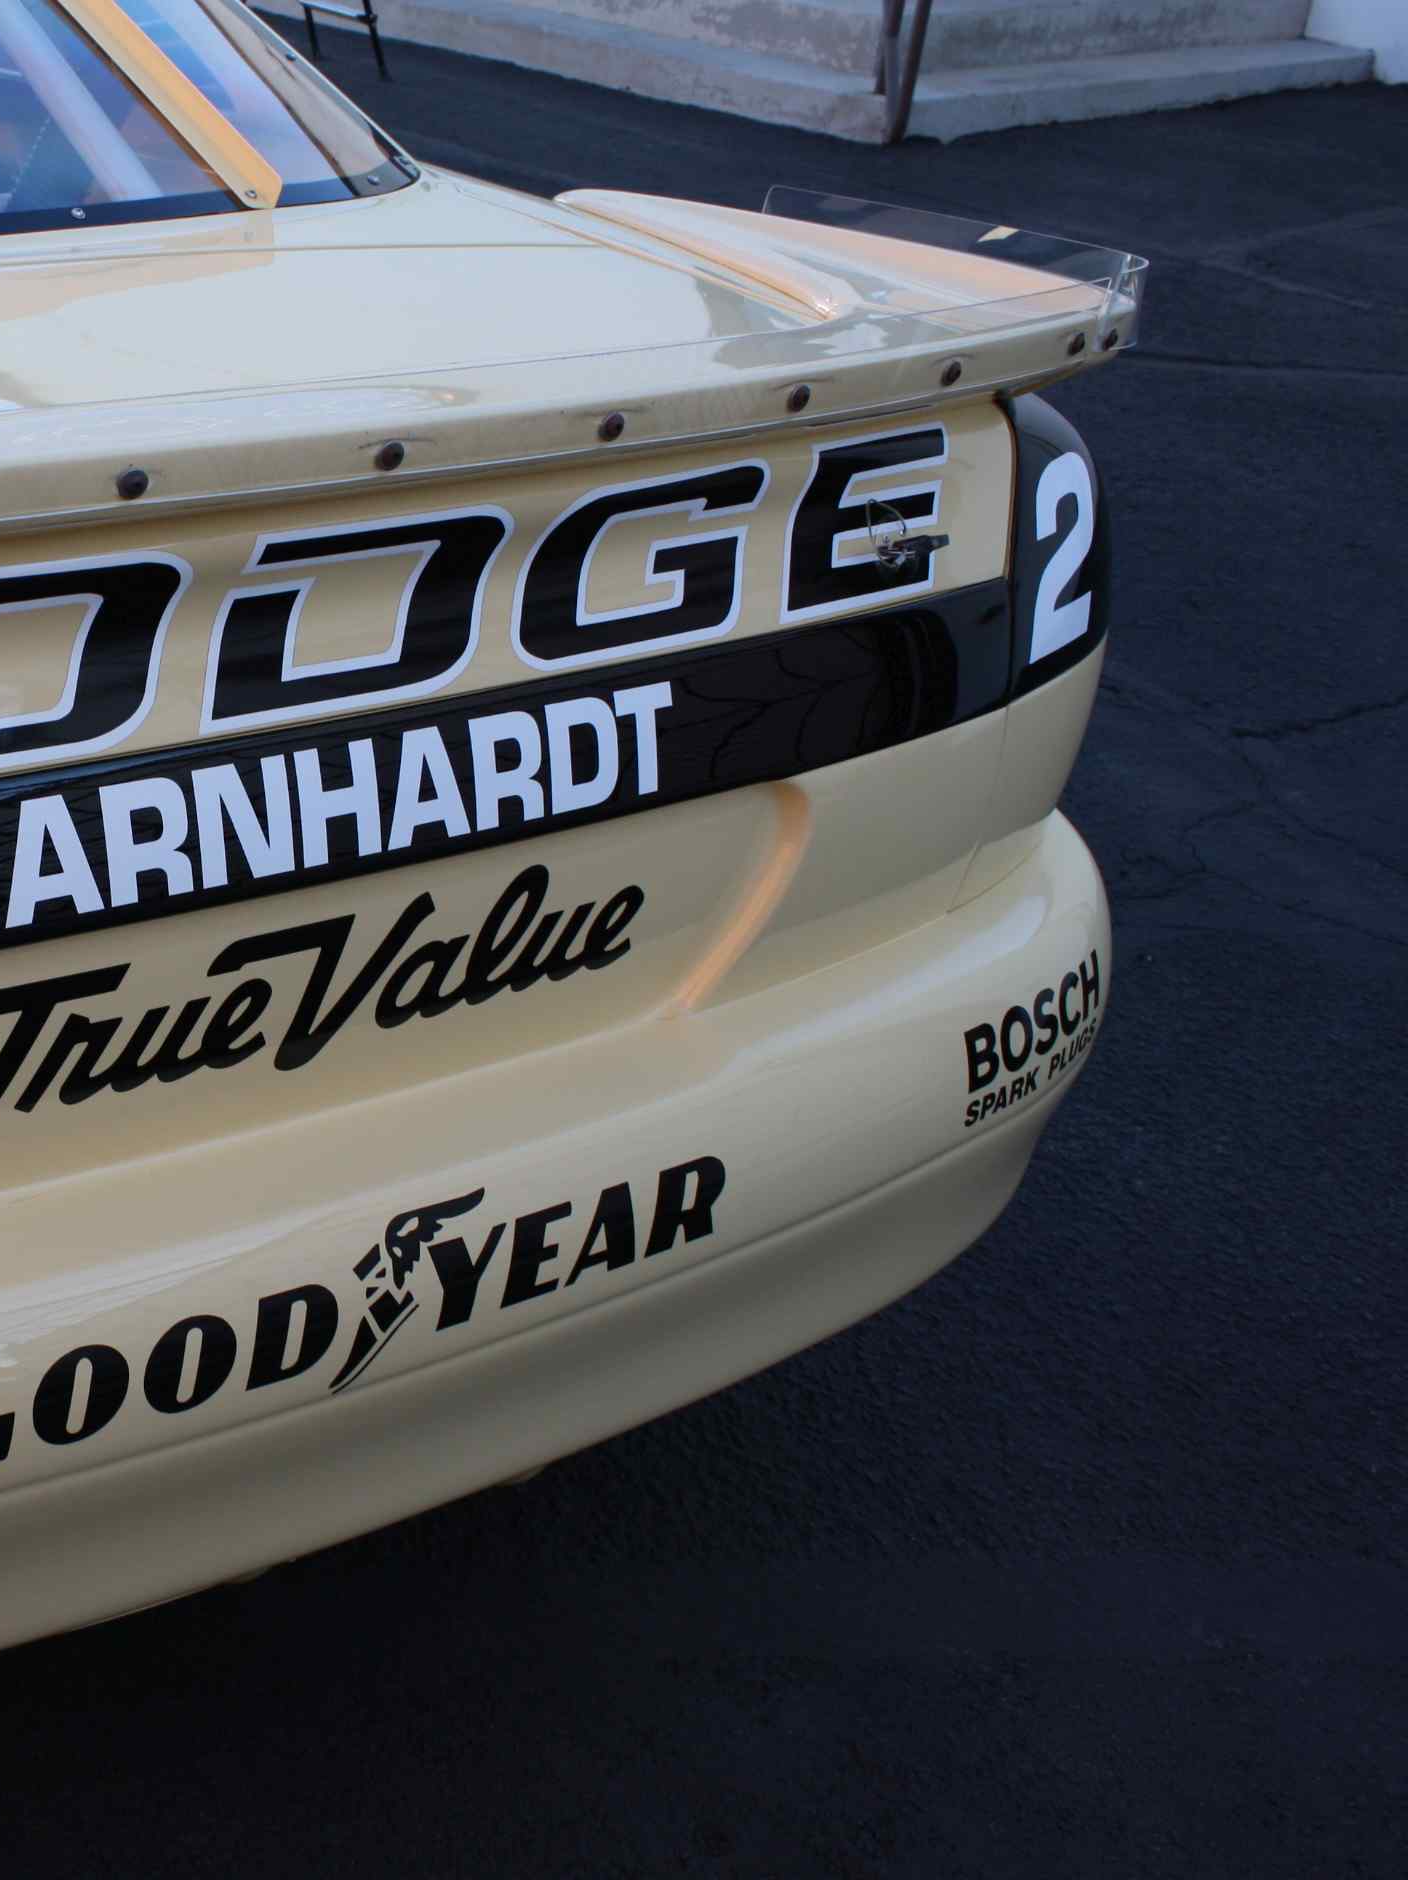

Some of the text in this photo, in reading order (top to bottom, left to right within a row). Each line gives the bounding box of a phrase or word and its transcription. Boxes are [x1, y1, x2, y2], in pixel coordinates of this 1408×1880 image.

[1029, 451, 1093, 664] 2
[964, 949, 1099, 1094] BOSCH
[964, 1066, 1040, 1127] SPARK
